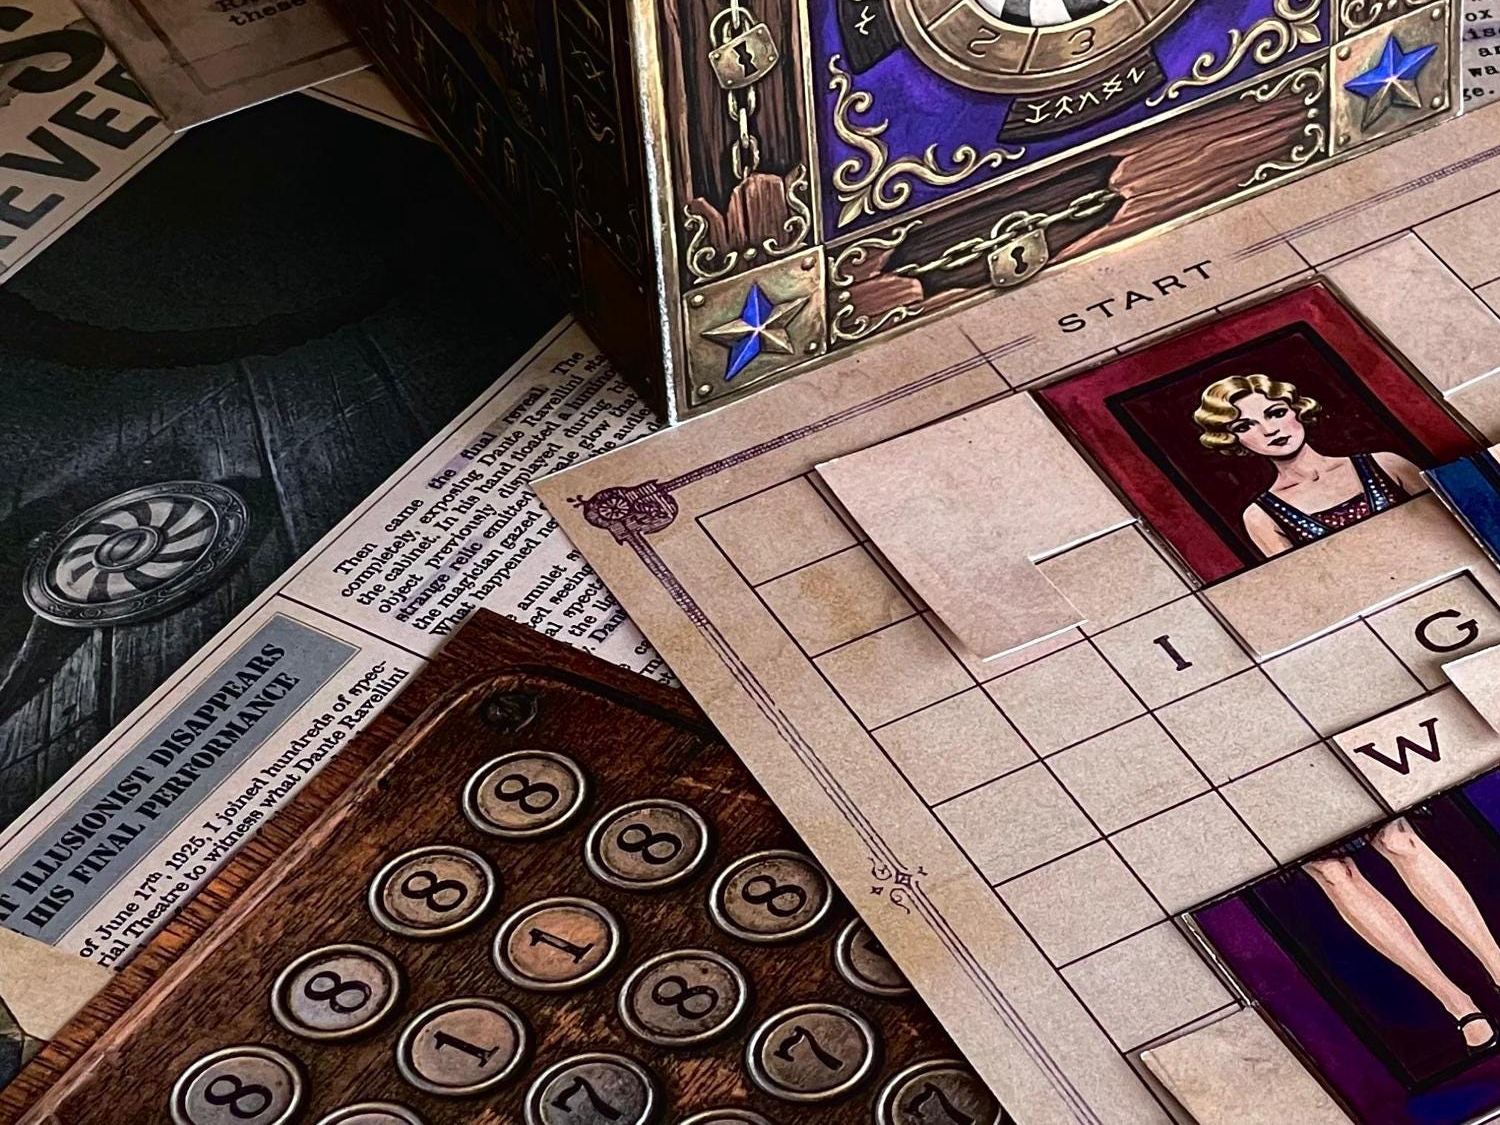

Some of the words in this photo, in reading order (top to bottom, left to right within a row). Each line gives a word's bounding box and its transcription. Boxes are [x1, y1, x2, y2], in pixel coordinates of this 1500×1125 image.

[1067, 27, 1096, 56] 3
[1058, 258, 1216, 336] START
[418, 469, 486, 526] exposing
[475, 427, 528, 468] Dante
[521, 374, 586, 430] Ravellini
[332, 540, 379, 577] Then
[460, 431, 500, 462] final
[377, 571, 426, 615] object
[422, 501, 499, 573] previously
[496, 442, 564, 500] displayed
[562, 399, 614, 443] during
[394, 572, 451, 625] strange
[447, 538, 485, 572] relic
[480, 490, 537, 541] emitted
[437, 547, 504, 612] magician
[427, 597, 478, 638] What
[470, 534, 540, 603] happened
[516, 561, 570, 613] amulet
[1150, 633, 1193, 672] I
[1413, 607, 1481, 654] G
[20, 764, 157, 896] ILLUSIONIST
[145, 641, 289, 771] DISAPPEARS
[1354, 716, 1445, 778] W
[22, 883, 79, 931] HIS
[67, 811, 145, 887] FINAL
[134, 671, 302, 822] PERFORMANCE
[92, 897, 143, 943] June
[212, 769, 271, 830] joined
[262, 710, 337, 785] hundreds
[349, 659, 392, 702] spec-
[119, 876, 194, 941] Theatre
[205, 807, 269, 868] witness
[294, 727, 350, 783] Dante
[337, 663, 414, 736] Ravellini
[493, 771, 560, 817] 8
[616, 820, 683, 867] 8
[400, 867, 468, 915] 8
[741, 872, 808, 919] 8
[527, 924, 597, 966] 1
[303, 968, 372, 1017] 8
[651, 973, 720, 1022] 8
[433, 1028, 502, 1070] 1
[781, 1024, 846, 1073] 7
[203, 1073, 273, 1123] 8
